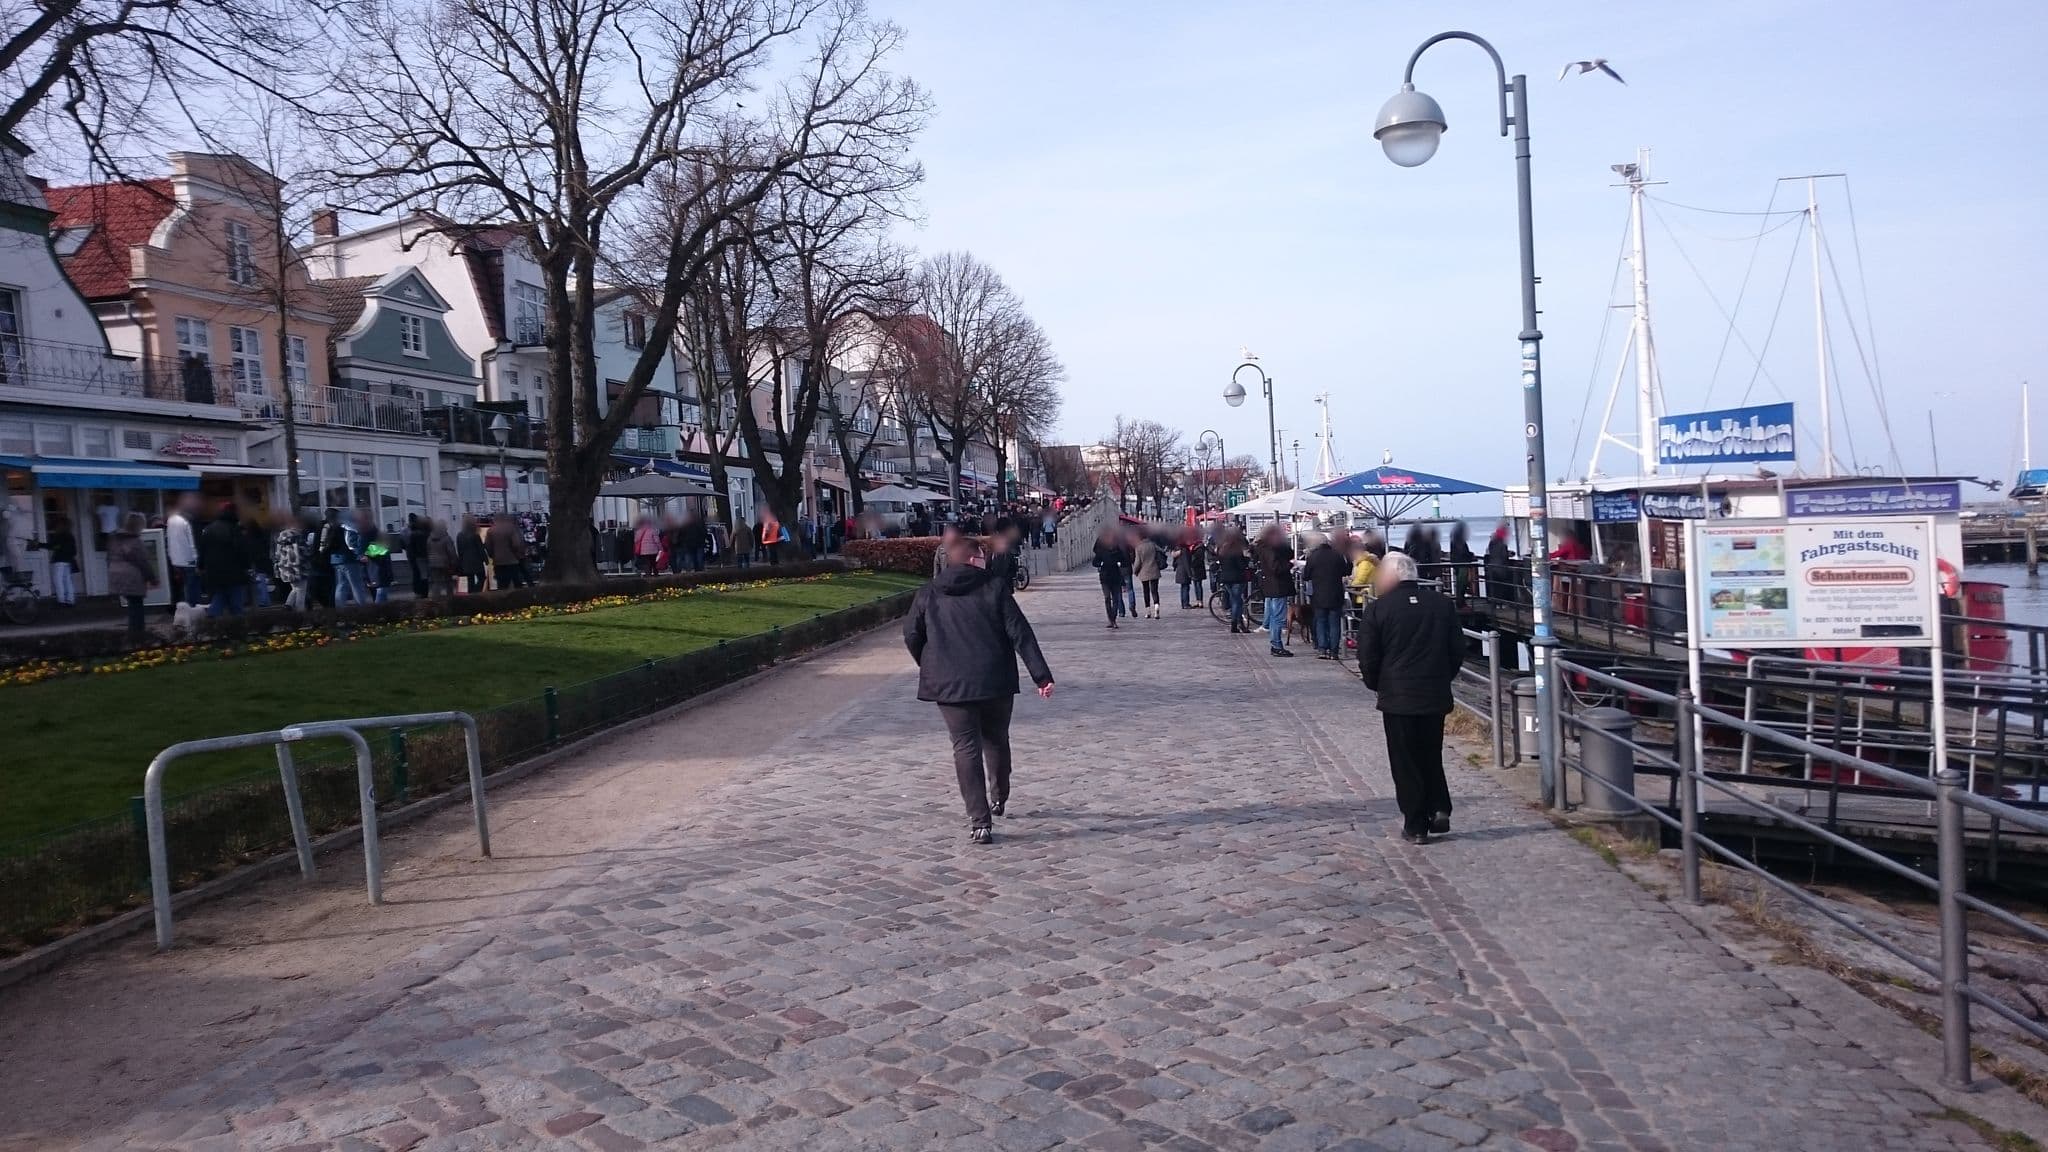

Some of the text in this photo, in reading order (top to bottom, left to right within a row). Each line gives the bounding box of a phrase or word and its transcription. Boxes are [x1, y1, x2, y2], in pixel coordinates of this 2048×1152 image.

[1794, 491, 1952, 513] FutterKutter
[1833, 530, 1884, 539] Mit dem
[1801, 540, 1919, 562] Fahrgastschiff
[1811, 570, 1908, 582] Schnatermann
